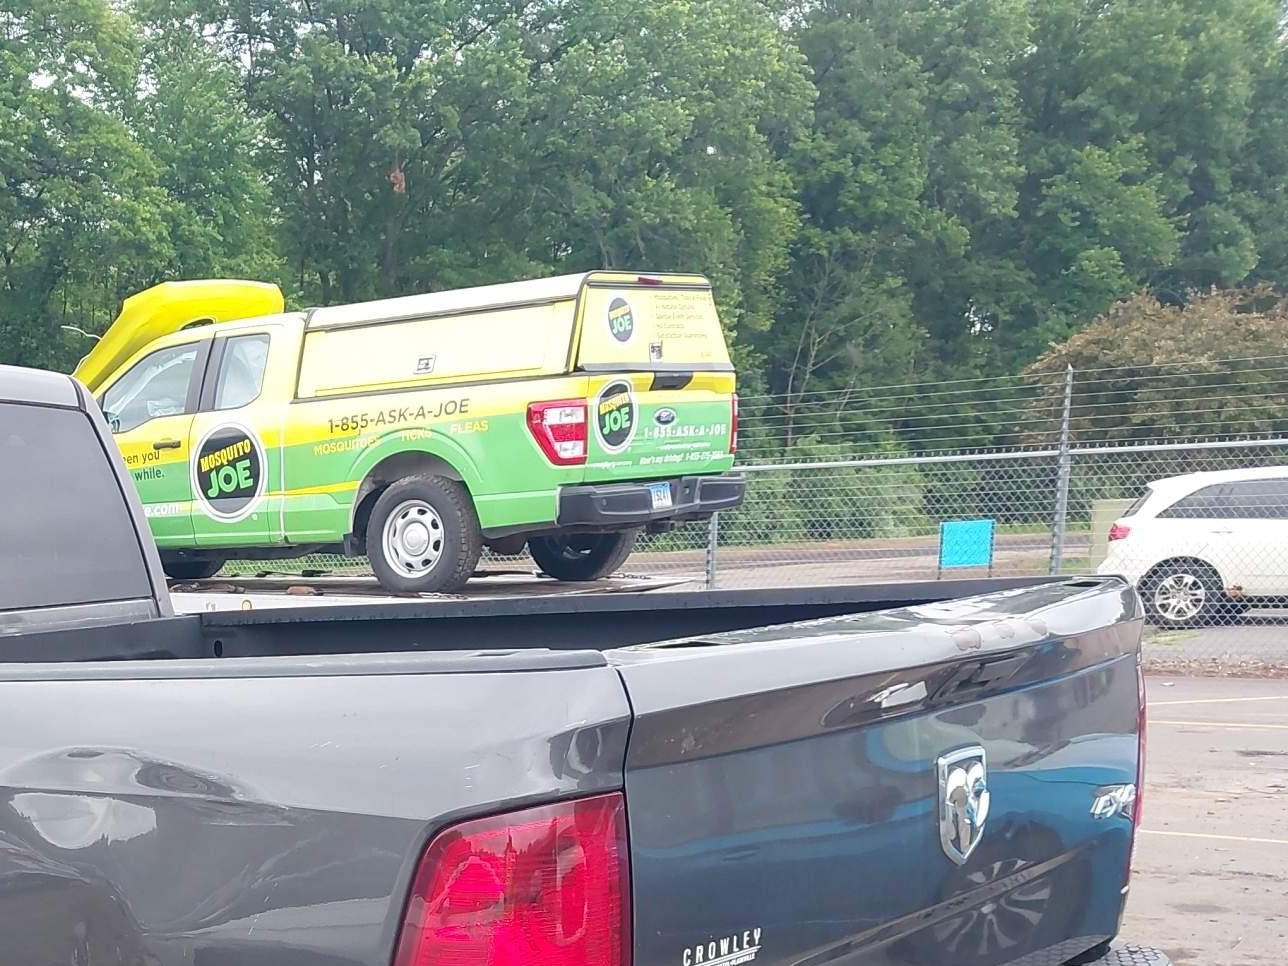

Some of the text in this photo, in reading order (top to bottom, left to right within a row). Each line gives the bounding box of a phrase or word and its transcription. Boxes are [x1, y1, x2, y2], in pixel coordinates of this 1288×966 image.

[613, 315, 631, 334] JOE
[328, 398, 470, 433] 1-855-ASK-A-JOE
[449, 420, 489, 434] FLEAS
[602, 407, 631, 435] JOE
[142, 450, 160, 465] you
[199, 439, 252, 472] MOSQUITO
[134, 467, 165, 481] while.
[207, 459, 254, 498] JOE
[683, 927, 761, 966] CROWLEY
